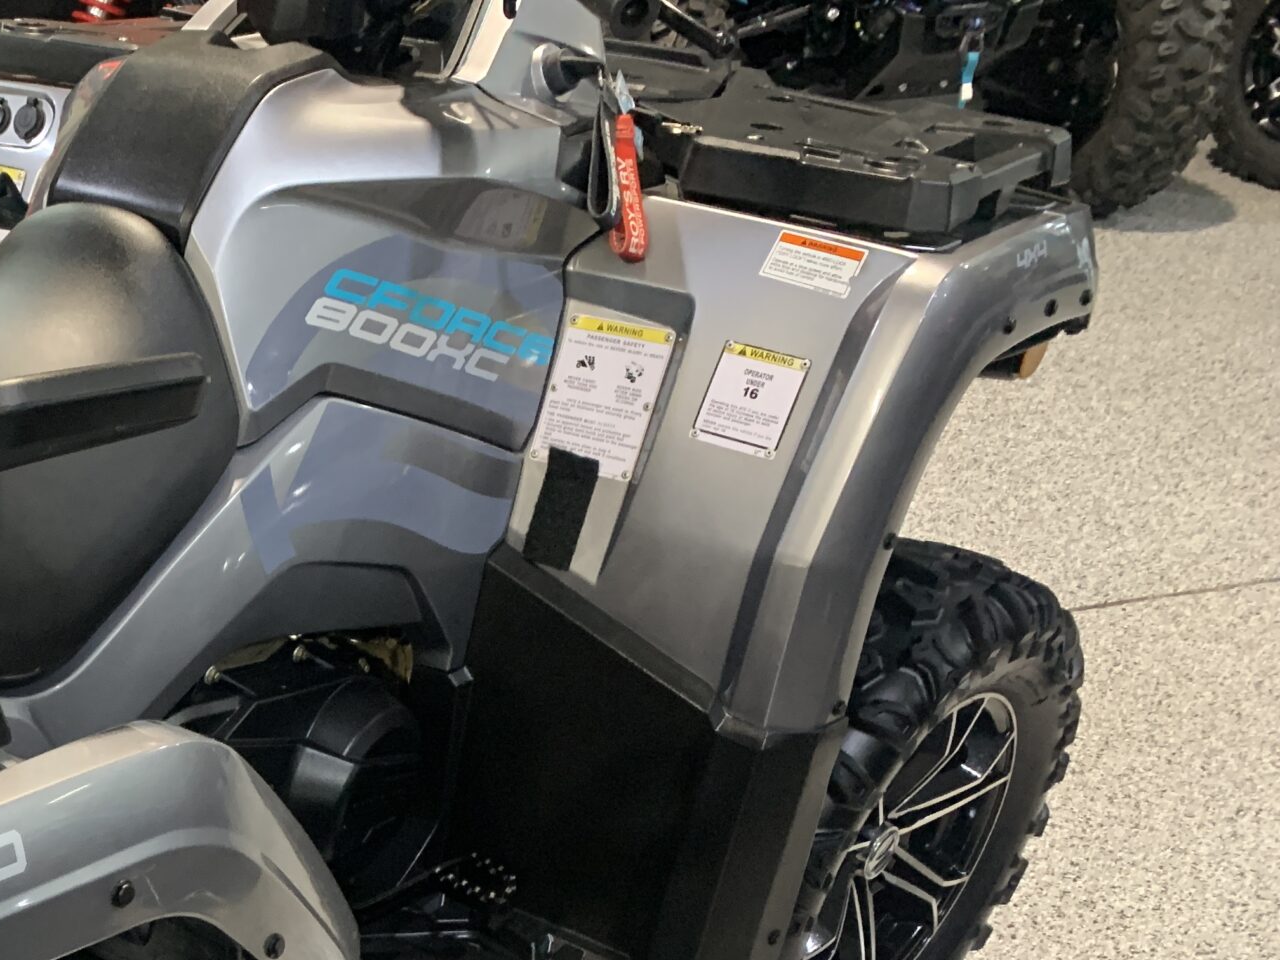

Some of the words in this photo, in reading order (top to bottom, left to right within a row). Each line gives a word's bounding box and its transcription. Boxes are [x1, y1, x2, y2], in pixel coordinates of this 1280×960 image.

[616, 156, 630, 185] RV
[606, 323, 645, 338] WARNING
[305, 296, 510, 382] 800XC
[586, 333, 621, 345] PASSENGER
[623, 339, 646, 349] SAFETY
[749, 348, 795, 367] WARNING
[743, 368, 775, 382] OPERATOR
[745, 378, 766, 389] UNDER
[743, 386, 760, 400] 16
